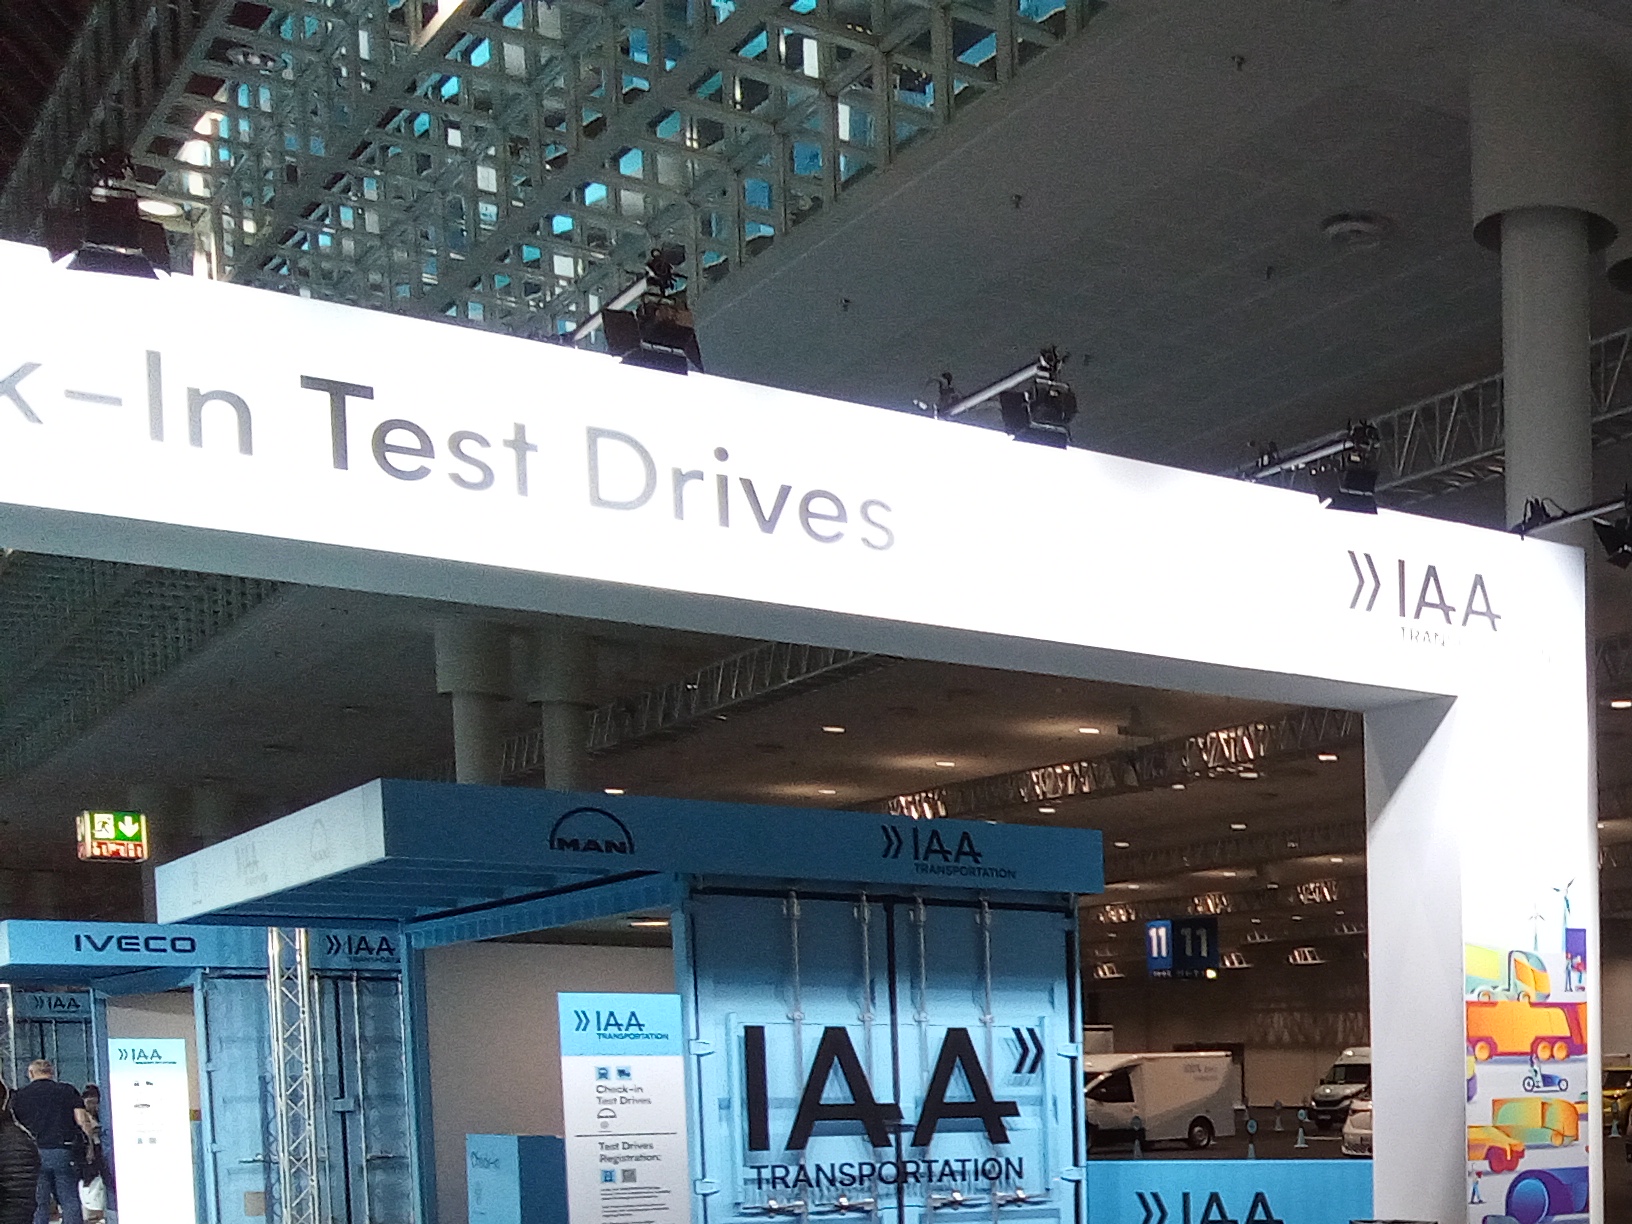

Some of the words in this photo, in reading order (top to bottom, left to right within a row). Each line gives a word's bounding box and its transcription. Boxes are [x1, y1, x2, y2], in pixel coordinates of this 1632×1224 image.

[300, 374, 538, 497] Test
[586, 425, 895, 551] Drives
[1398, 558, 1502, 632] IAA
[556, 837, 627, 854] MAN
[912, 825, 983, 863] IAA
[914, 862, 1017, 879] TRANSPORTATION
[75, 934, 197, 953] IVECO
[347, 934, 396, 956] IAA
[1149, 927, 1167, 958] 11
[1181, 927, 1208, 958] 11
[47, 996, 81, 1010] IAA
[595, 1010, 645, 1032] IAA
[131, 1048, 162, 1061] IAA
[744, 1025, 1021, 1151] IAA
[752, 1156, 1024, 1190] TRANSPORTATION
